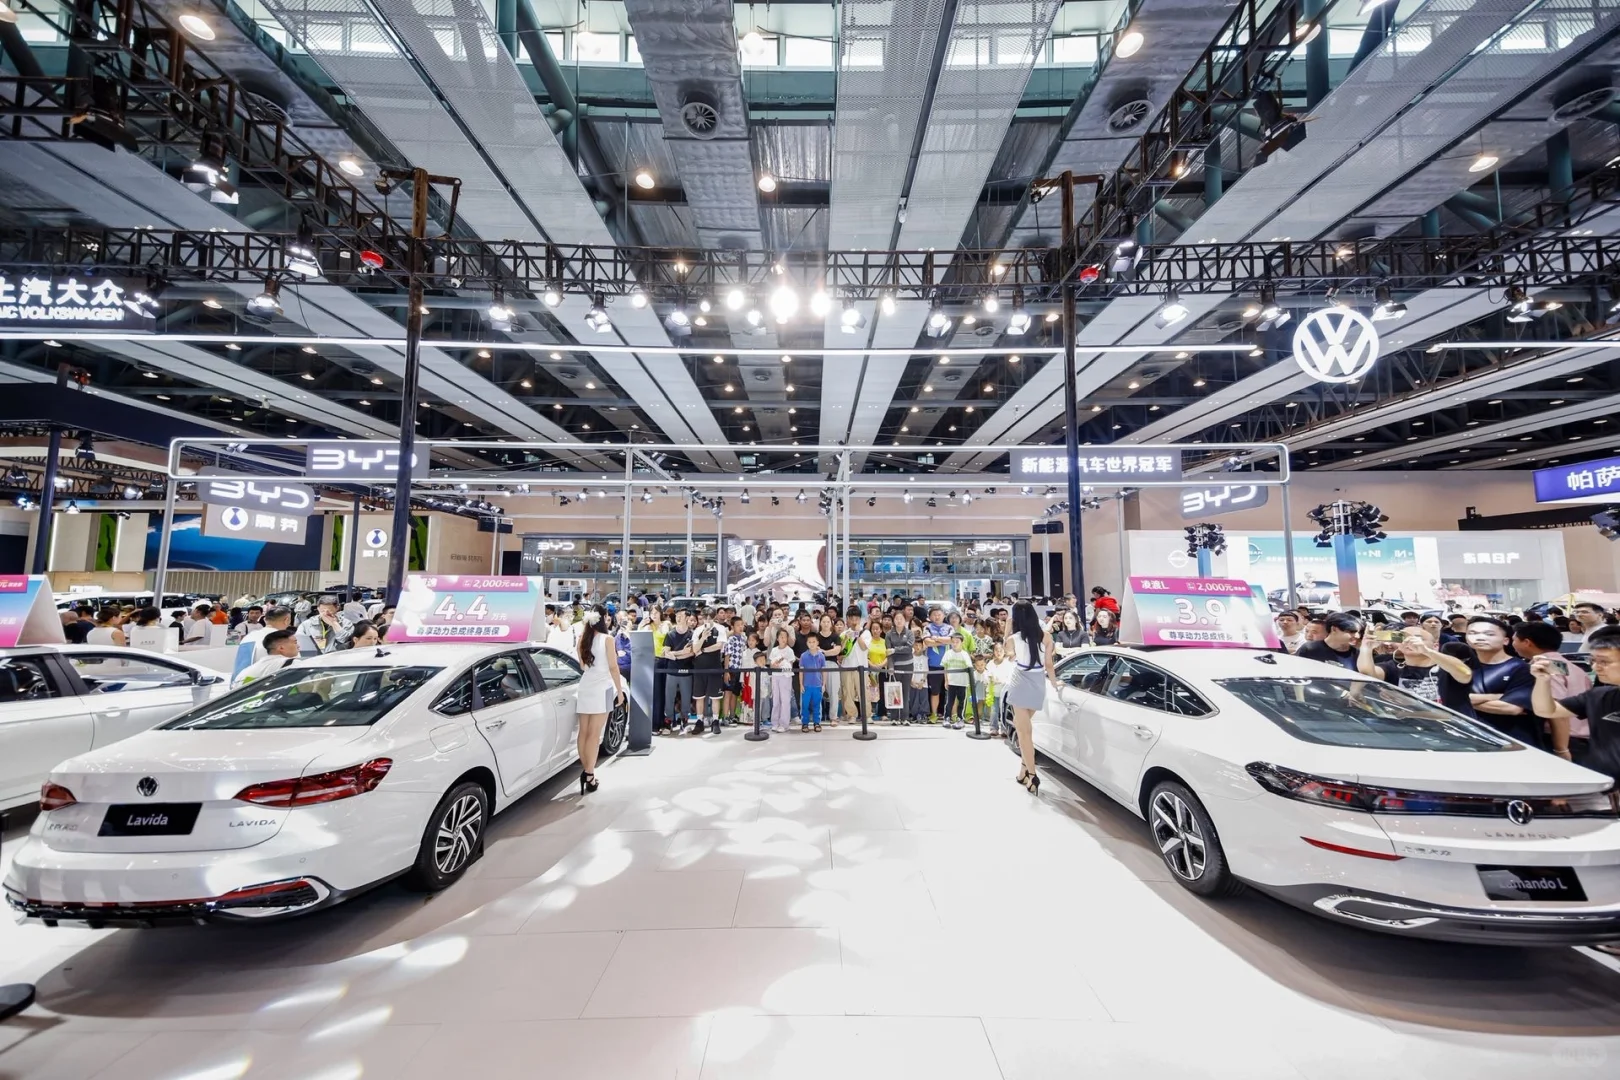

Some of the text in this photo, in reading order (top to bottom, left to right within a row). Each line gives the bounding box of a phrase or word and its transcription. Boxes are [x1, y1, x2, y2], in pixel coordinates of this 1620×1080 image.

[19, 306, 124, 321] VOLKSWAGEN
[312, 449, 418, 470] BYD
[209, 481, 309, 509] BYD
[1183, 485, 1257, 513] BYD
[538, 542, 575, 550] BYD
[974, 543, 1012, 551] BYD
[434, 594, 488, 621] 4.4
[126, 813, 168, 826] Lavida
[229, 819, 277, 828] LAVIDA
